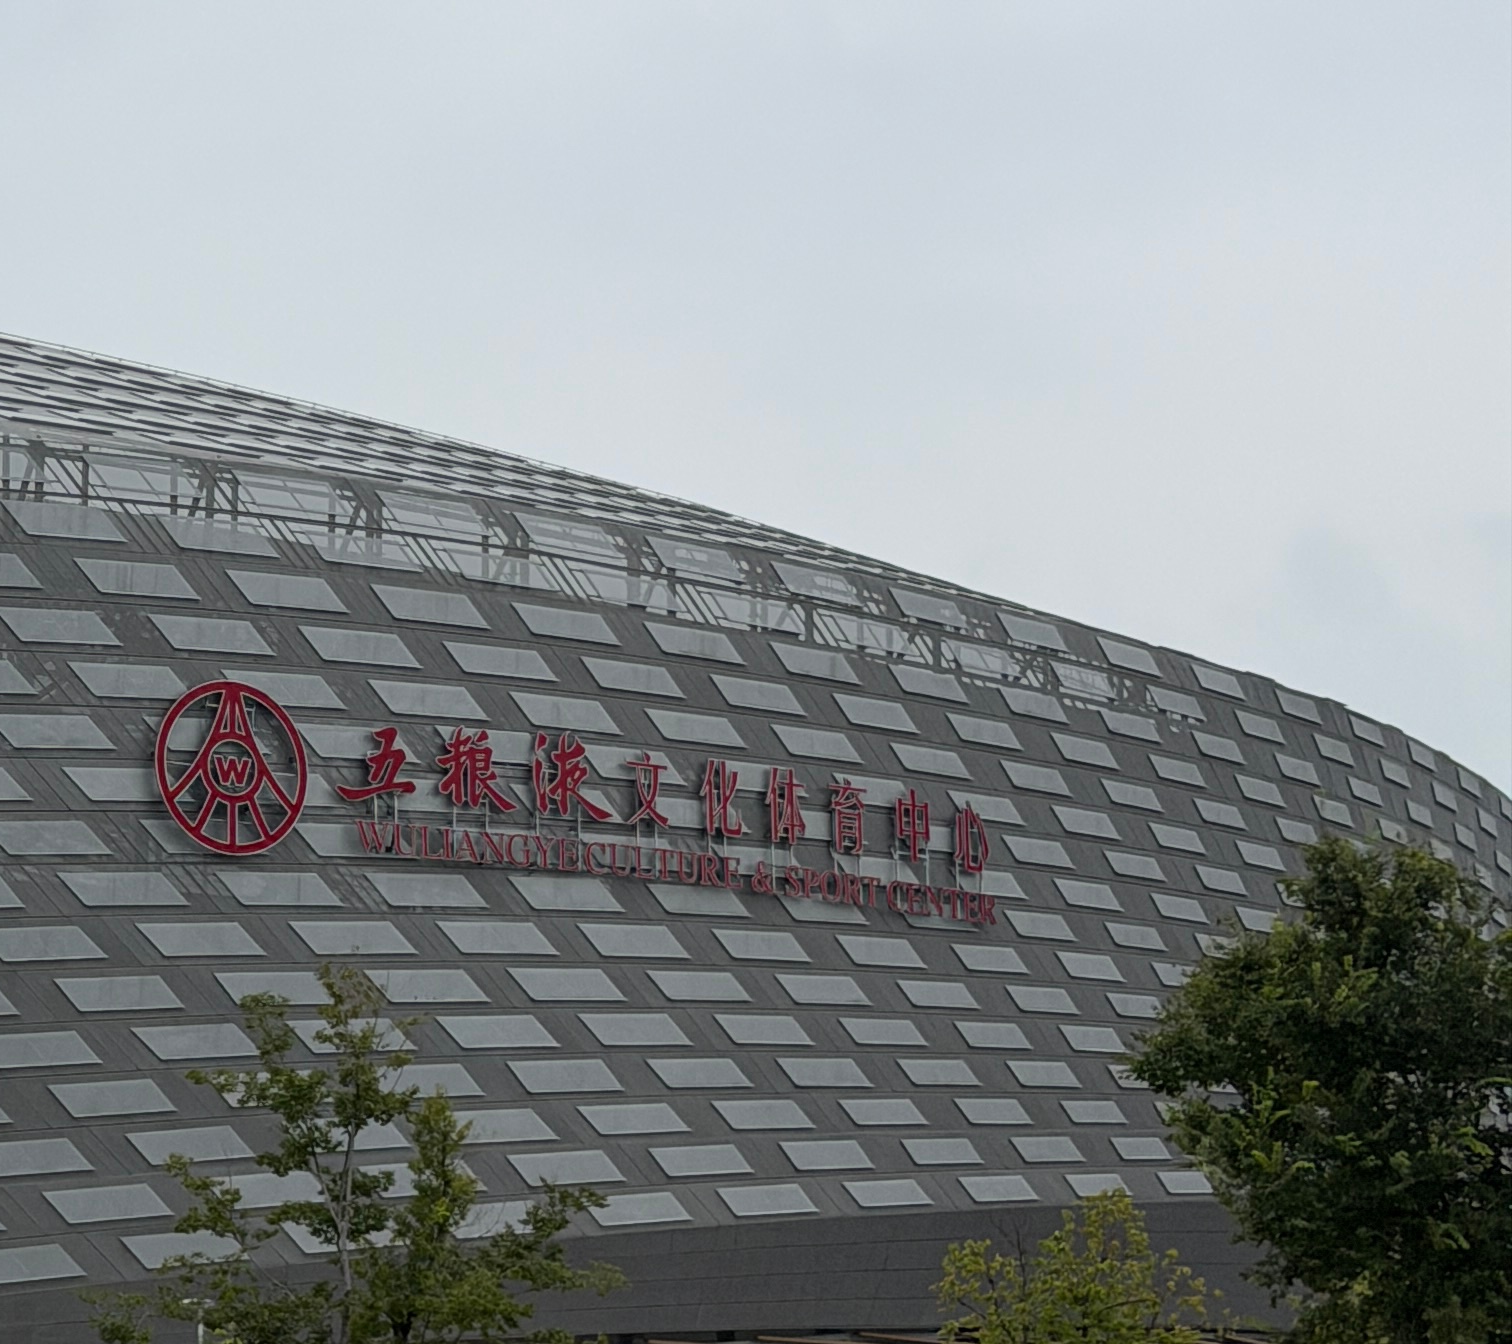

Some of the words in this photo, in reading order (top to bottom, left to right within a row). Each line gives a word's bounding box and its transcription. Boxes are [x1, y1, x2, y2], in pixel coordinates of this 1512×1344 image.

[214, 755, 251, 786] W
[335, 725, 990, 873] 五粮液文化体育中心
[355, 819, 581, 872] WULIANGYE
[583, 841, 743, 889] CULTURE
[751, 860, 775, 895] &
[784, 864, 881, 907] SPORT
[886, 879, 998, 925] CENTER
